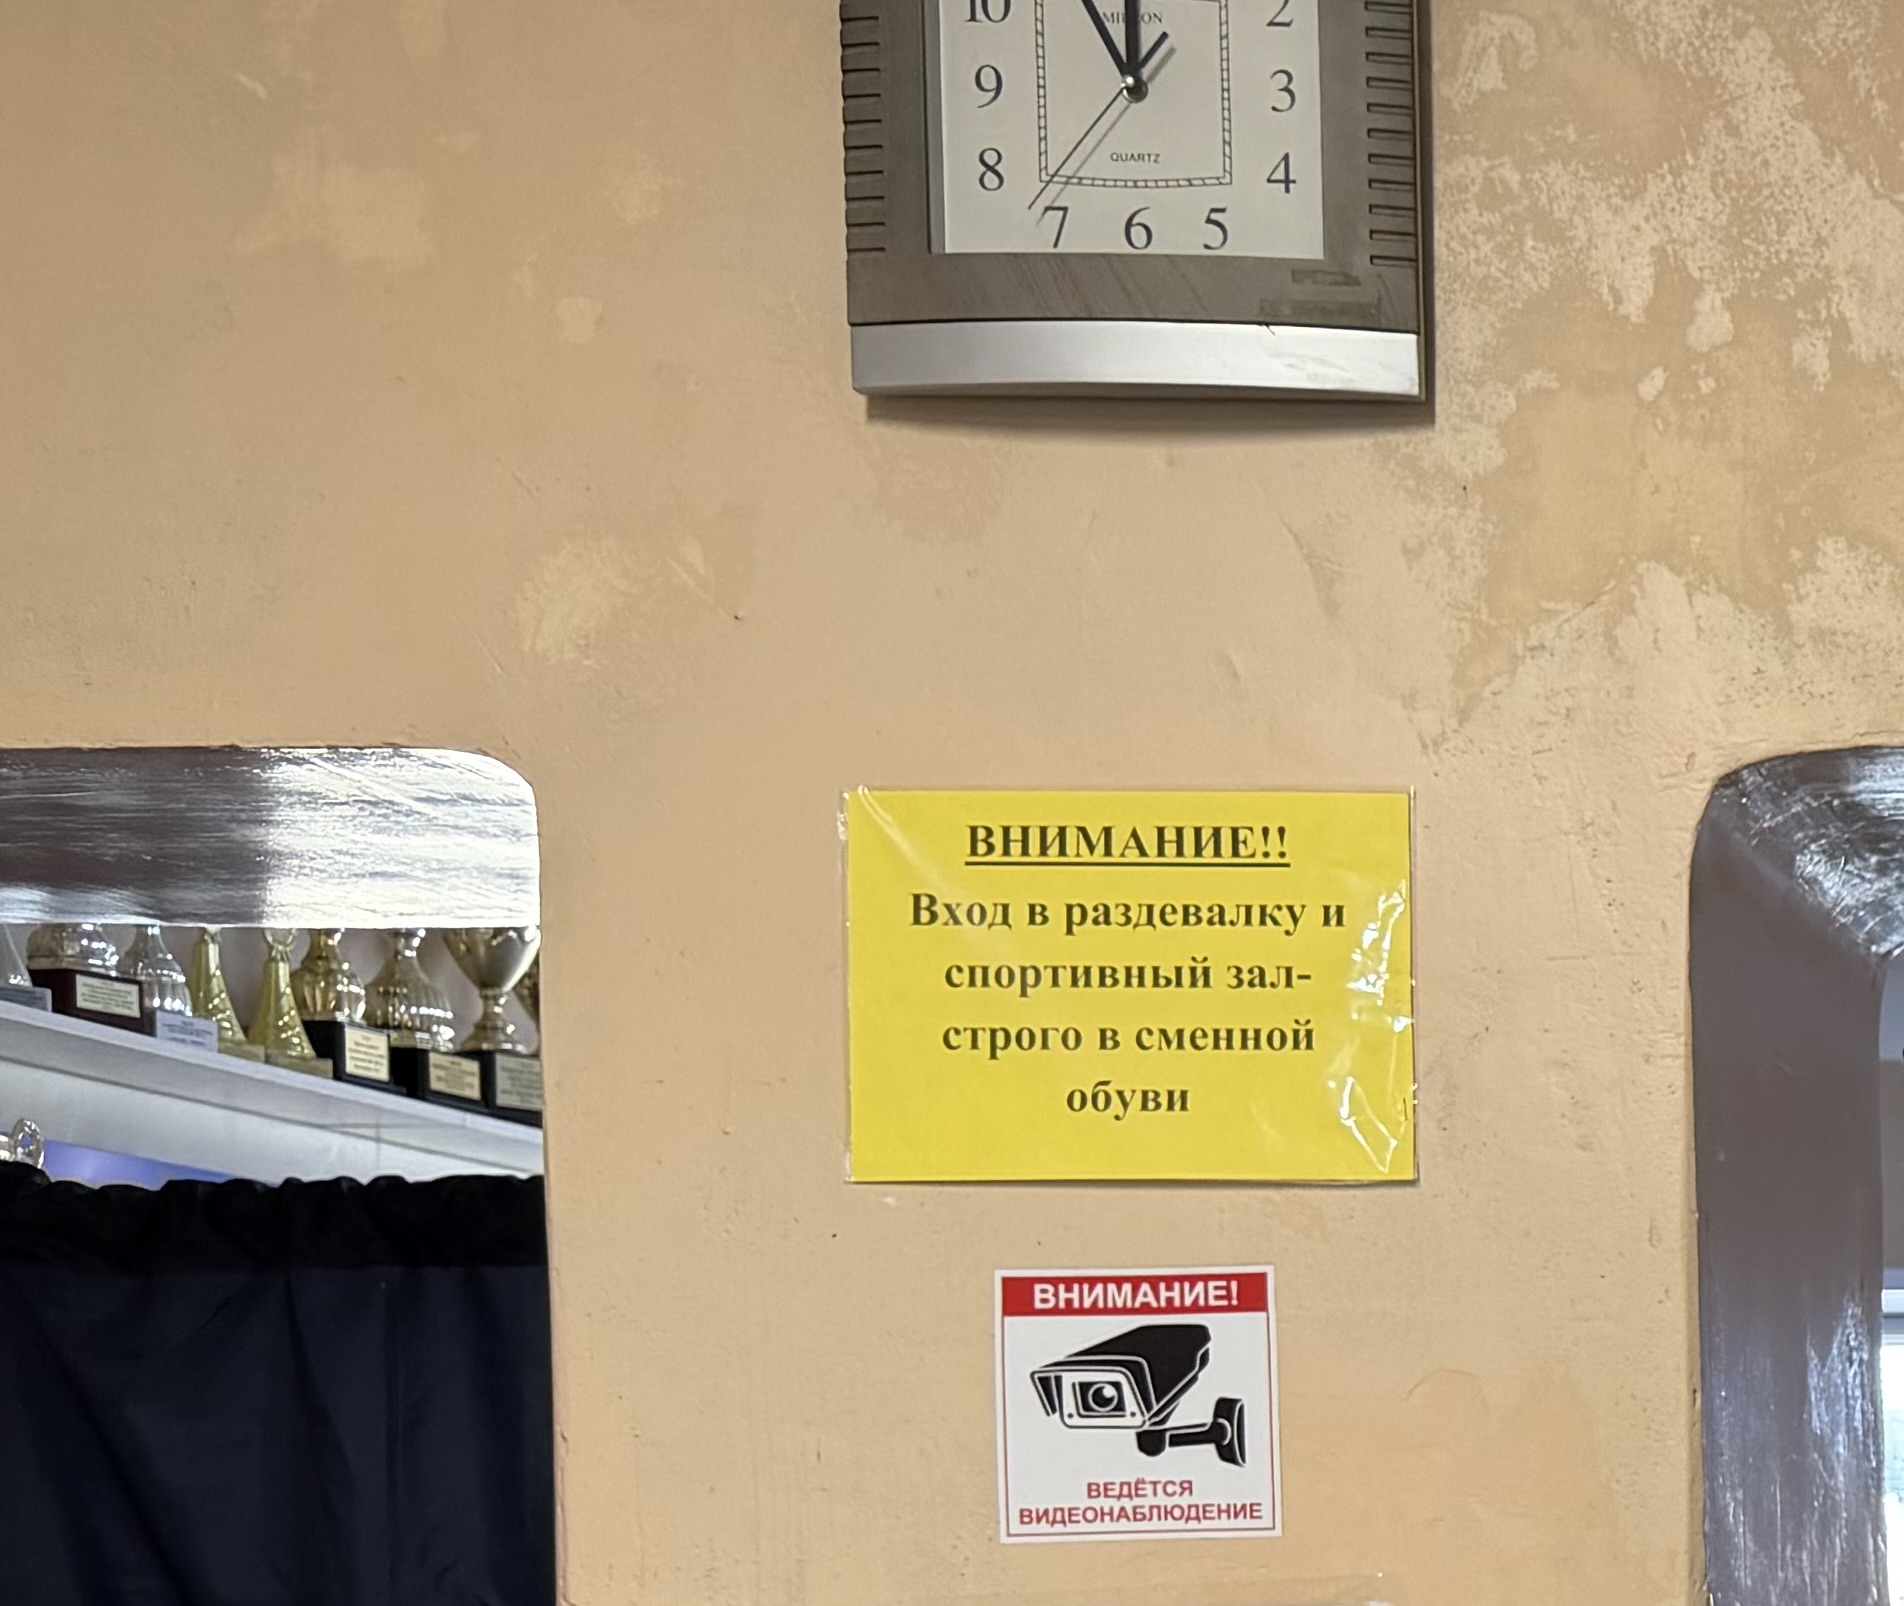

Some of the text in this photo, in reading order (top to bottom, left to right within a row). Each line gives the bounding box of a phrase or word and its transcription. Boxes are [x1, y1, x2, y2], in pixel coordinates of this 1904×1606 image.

[1266, 0, 1294, 28] 2
[975, 65, 1003, 108] 9
[1270, 69, 1296, 112] 3
[978, 148, 1004, 191] 8
[1110, 152, 1160, 164] QUARTZ
[1266, 152, 1296, 194] 4
[1042, 206, 1069, 248] 7
[1124, 207, 1153, 250] 6
[1203, 207, 1229, 250] 5
[967, 825, 1287, 859] ВНИМАНИЕ!!
[911, 893, 1345, 936] Вход в раздевалку и
[944, 958, 1312, 997] спортивный зал-
[942, 1018, 1315, 1060] строго в сменной
[1067, 1080, 1189, 1120] обуви
[1034, 1281, 1238, 1309] ВНИМАНИЕ!
[1087, 1478, 1193, 1501] ВЕДЁТСЯ
[1019, 1503, 1262, 1527] ВИДЕОНАБЛЮДЕНИЕ
